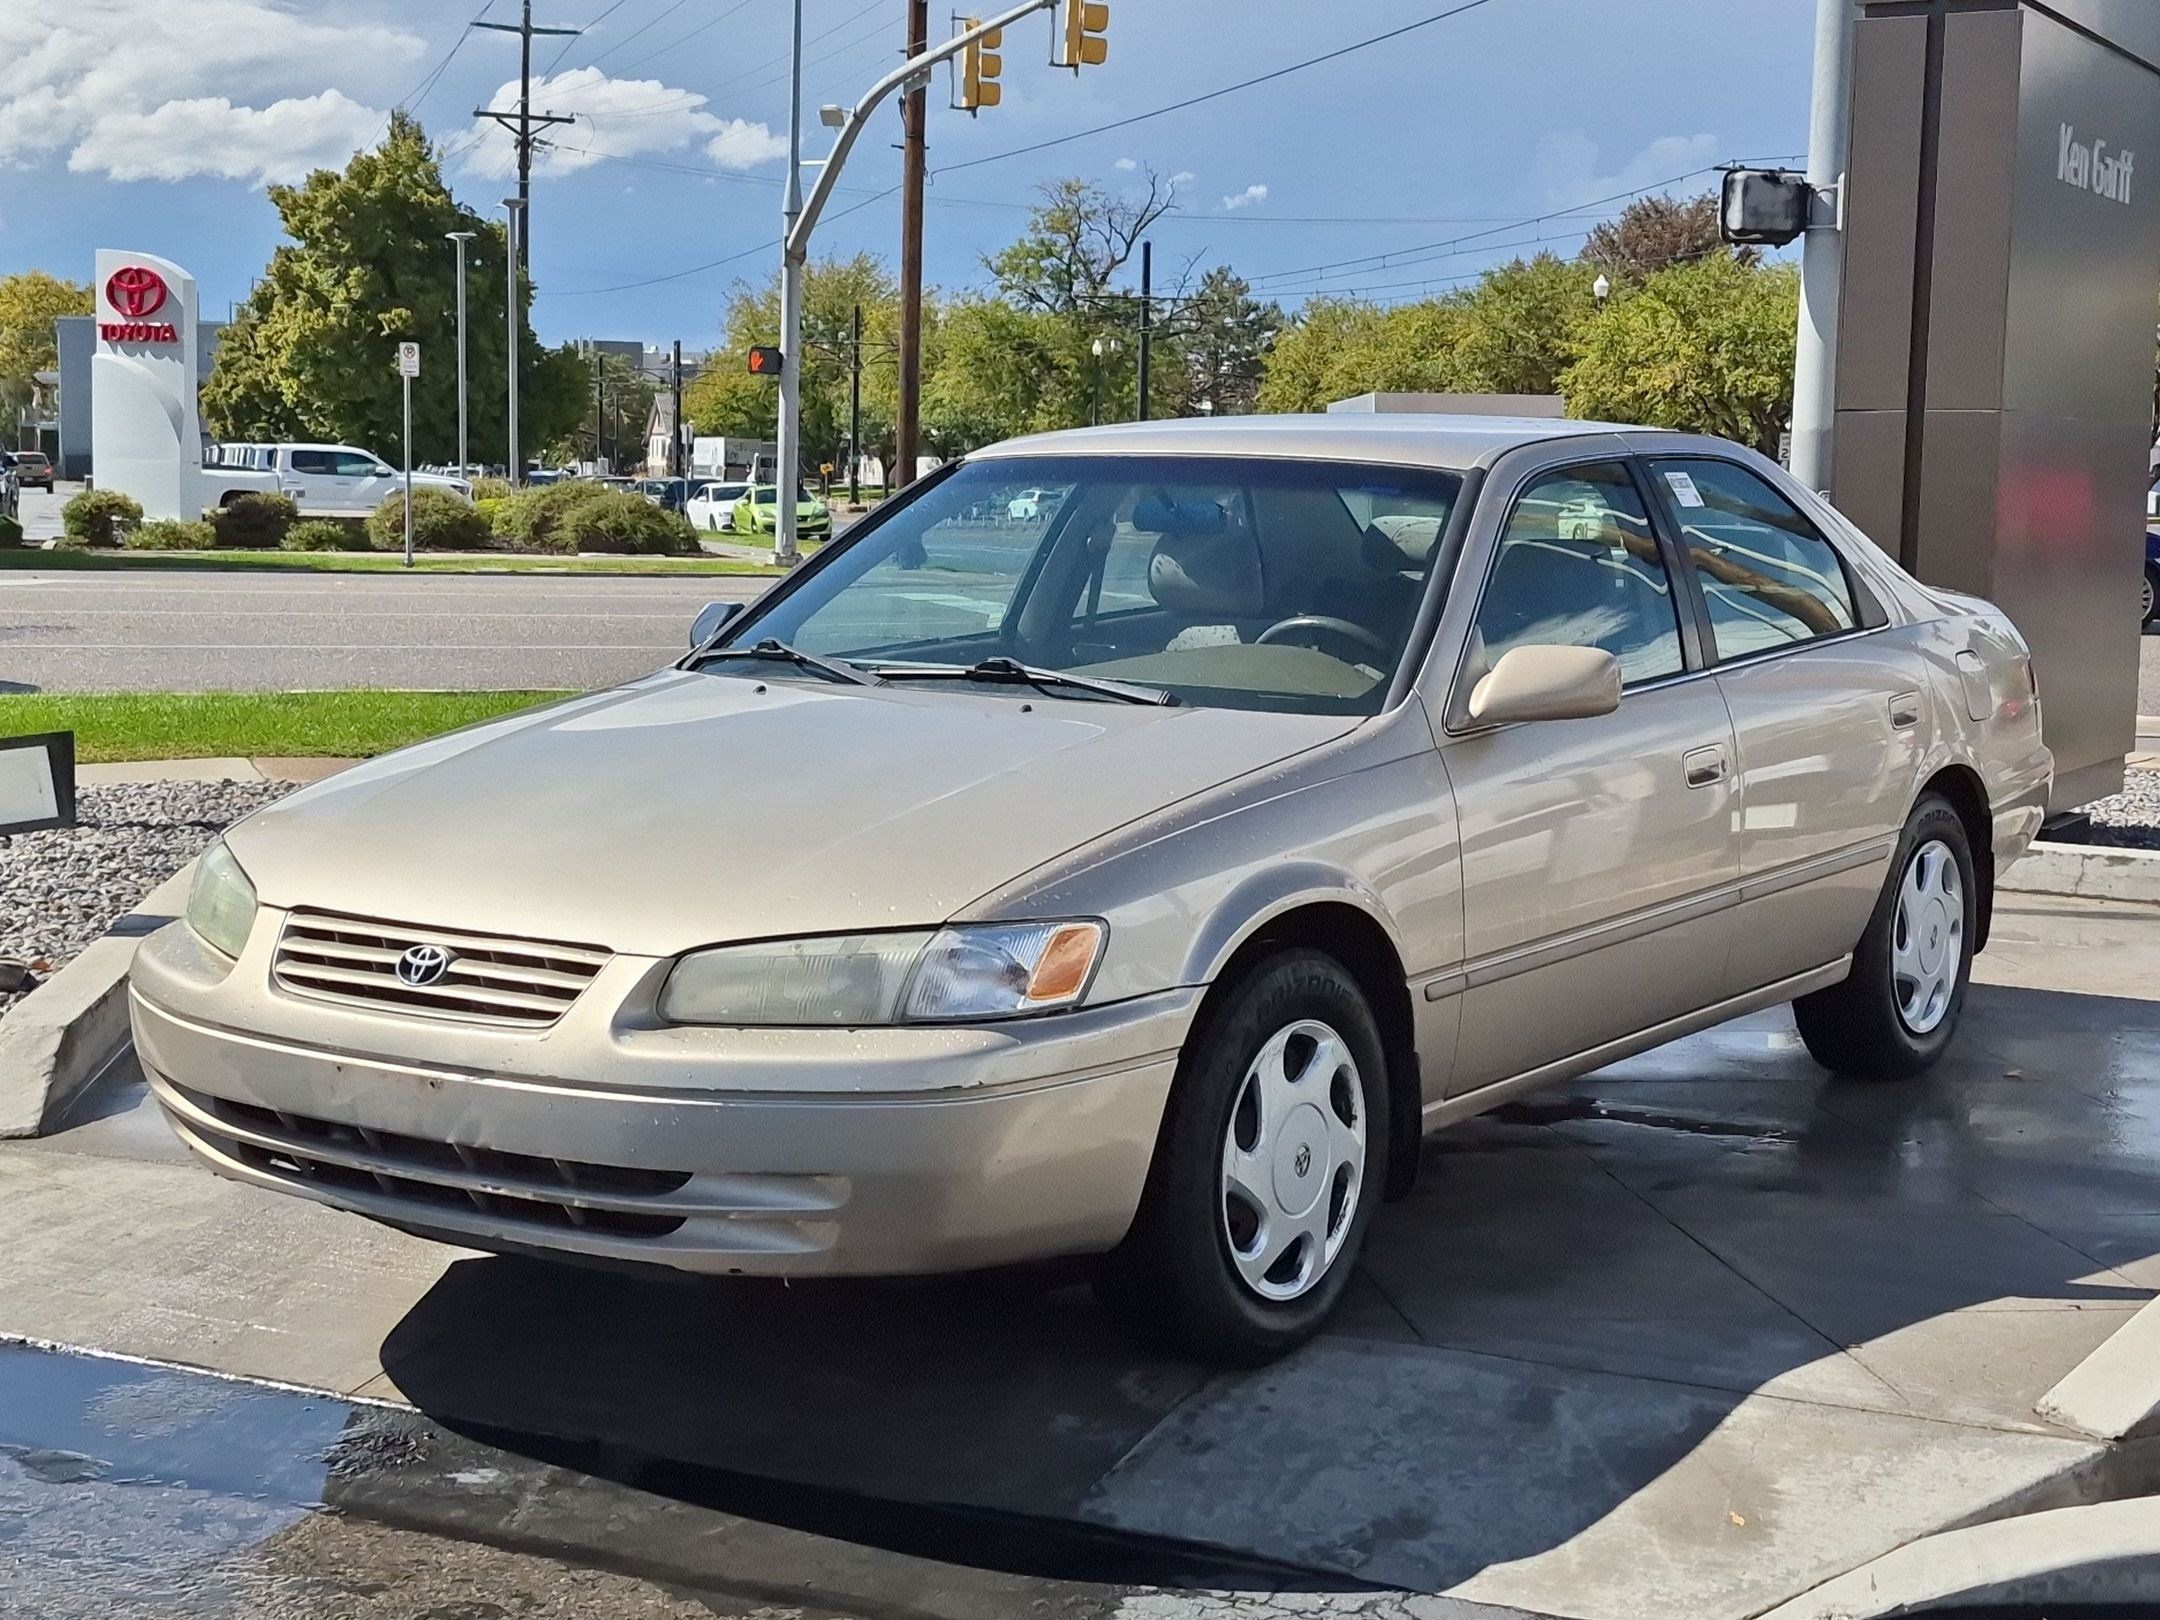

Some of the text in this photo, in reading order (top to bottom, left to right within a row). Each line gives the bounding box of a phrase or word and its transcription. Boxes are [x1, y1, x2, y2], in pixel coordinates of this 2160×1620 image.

[2058, 122, 2135, 205] Ken Garff
[98, 323, 178, 342] TOYOTA
